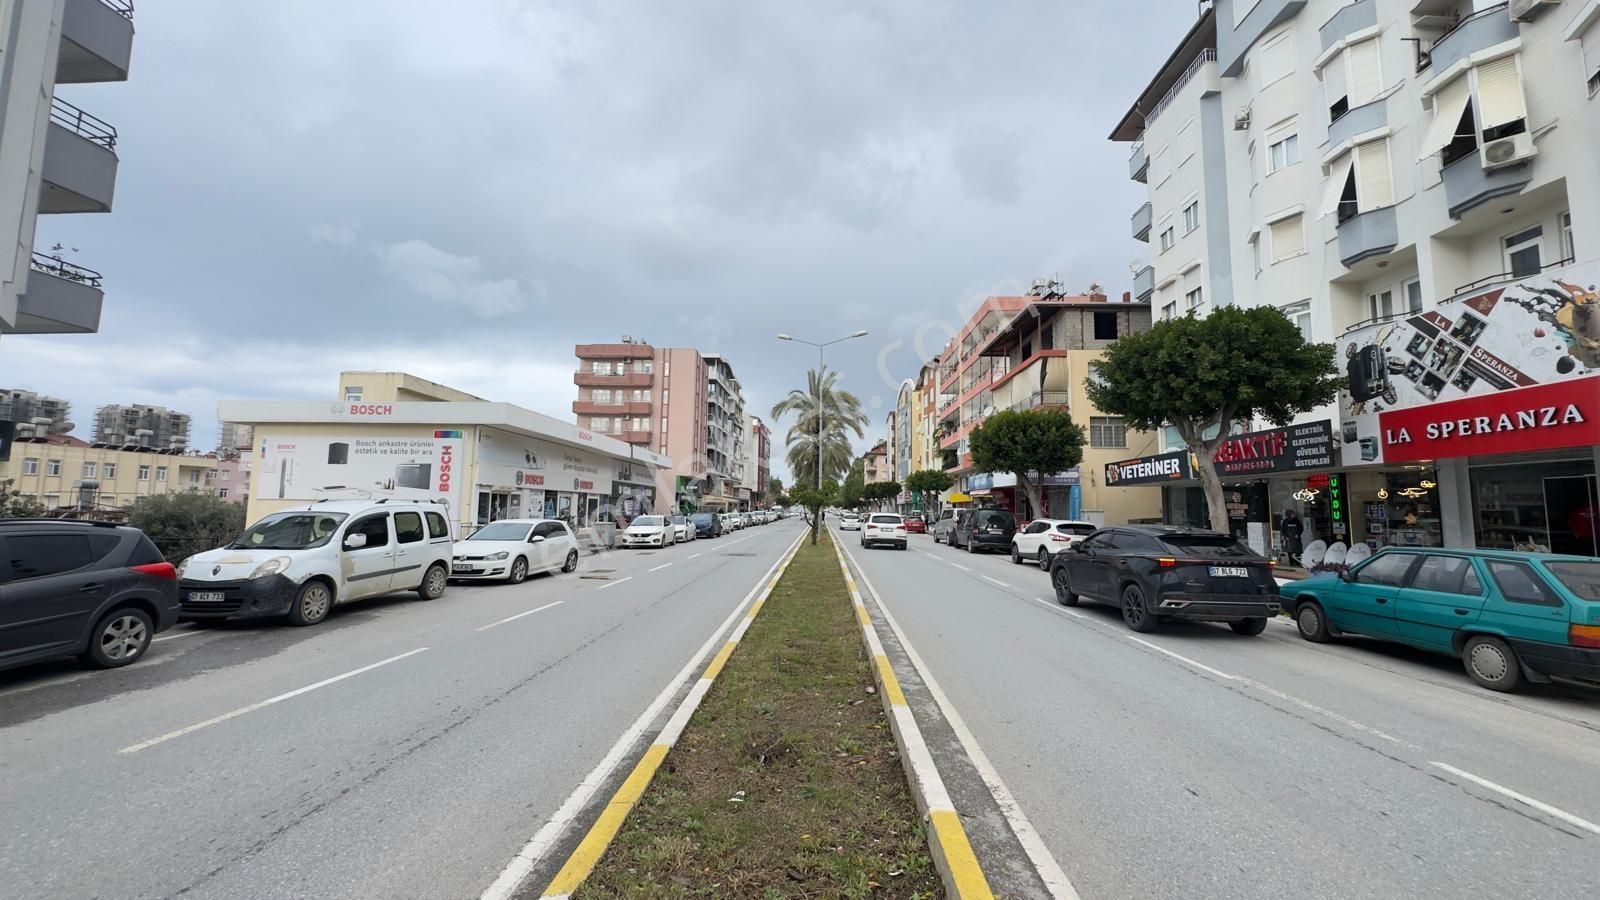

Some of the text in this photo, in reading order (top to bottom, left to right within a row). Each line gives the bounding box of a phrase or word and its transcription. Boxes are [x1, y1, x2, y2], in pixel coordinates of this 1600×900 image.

[350, 405, 392, 415] BOSCH
[1295, 424, 1324, 436] ELEKTRİK
[1386, 404, 1584, 444] LA SPERANZA
[1292, 434, 1329, 446] ELEKTRONİK
[1296, 445, 1327, 457] GÜVENLİK
[1295, 455, 1330, 467] SİSTEMLERİ
[438, 445, 452, 492] BOSCH
[1120, 458, 1181, 480] VETERİNER
[524, 473, 545, 486] BOSCH
[1330, 478, 1341, 520] UYDU
